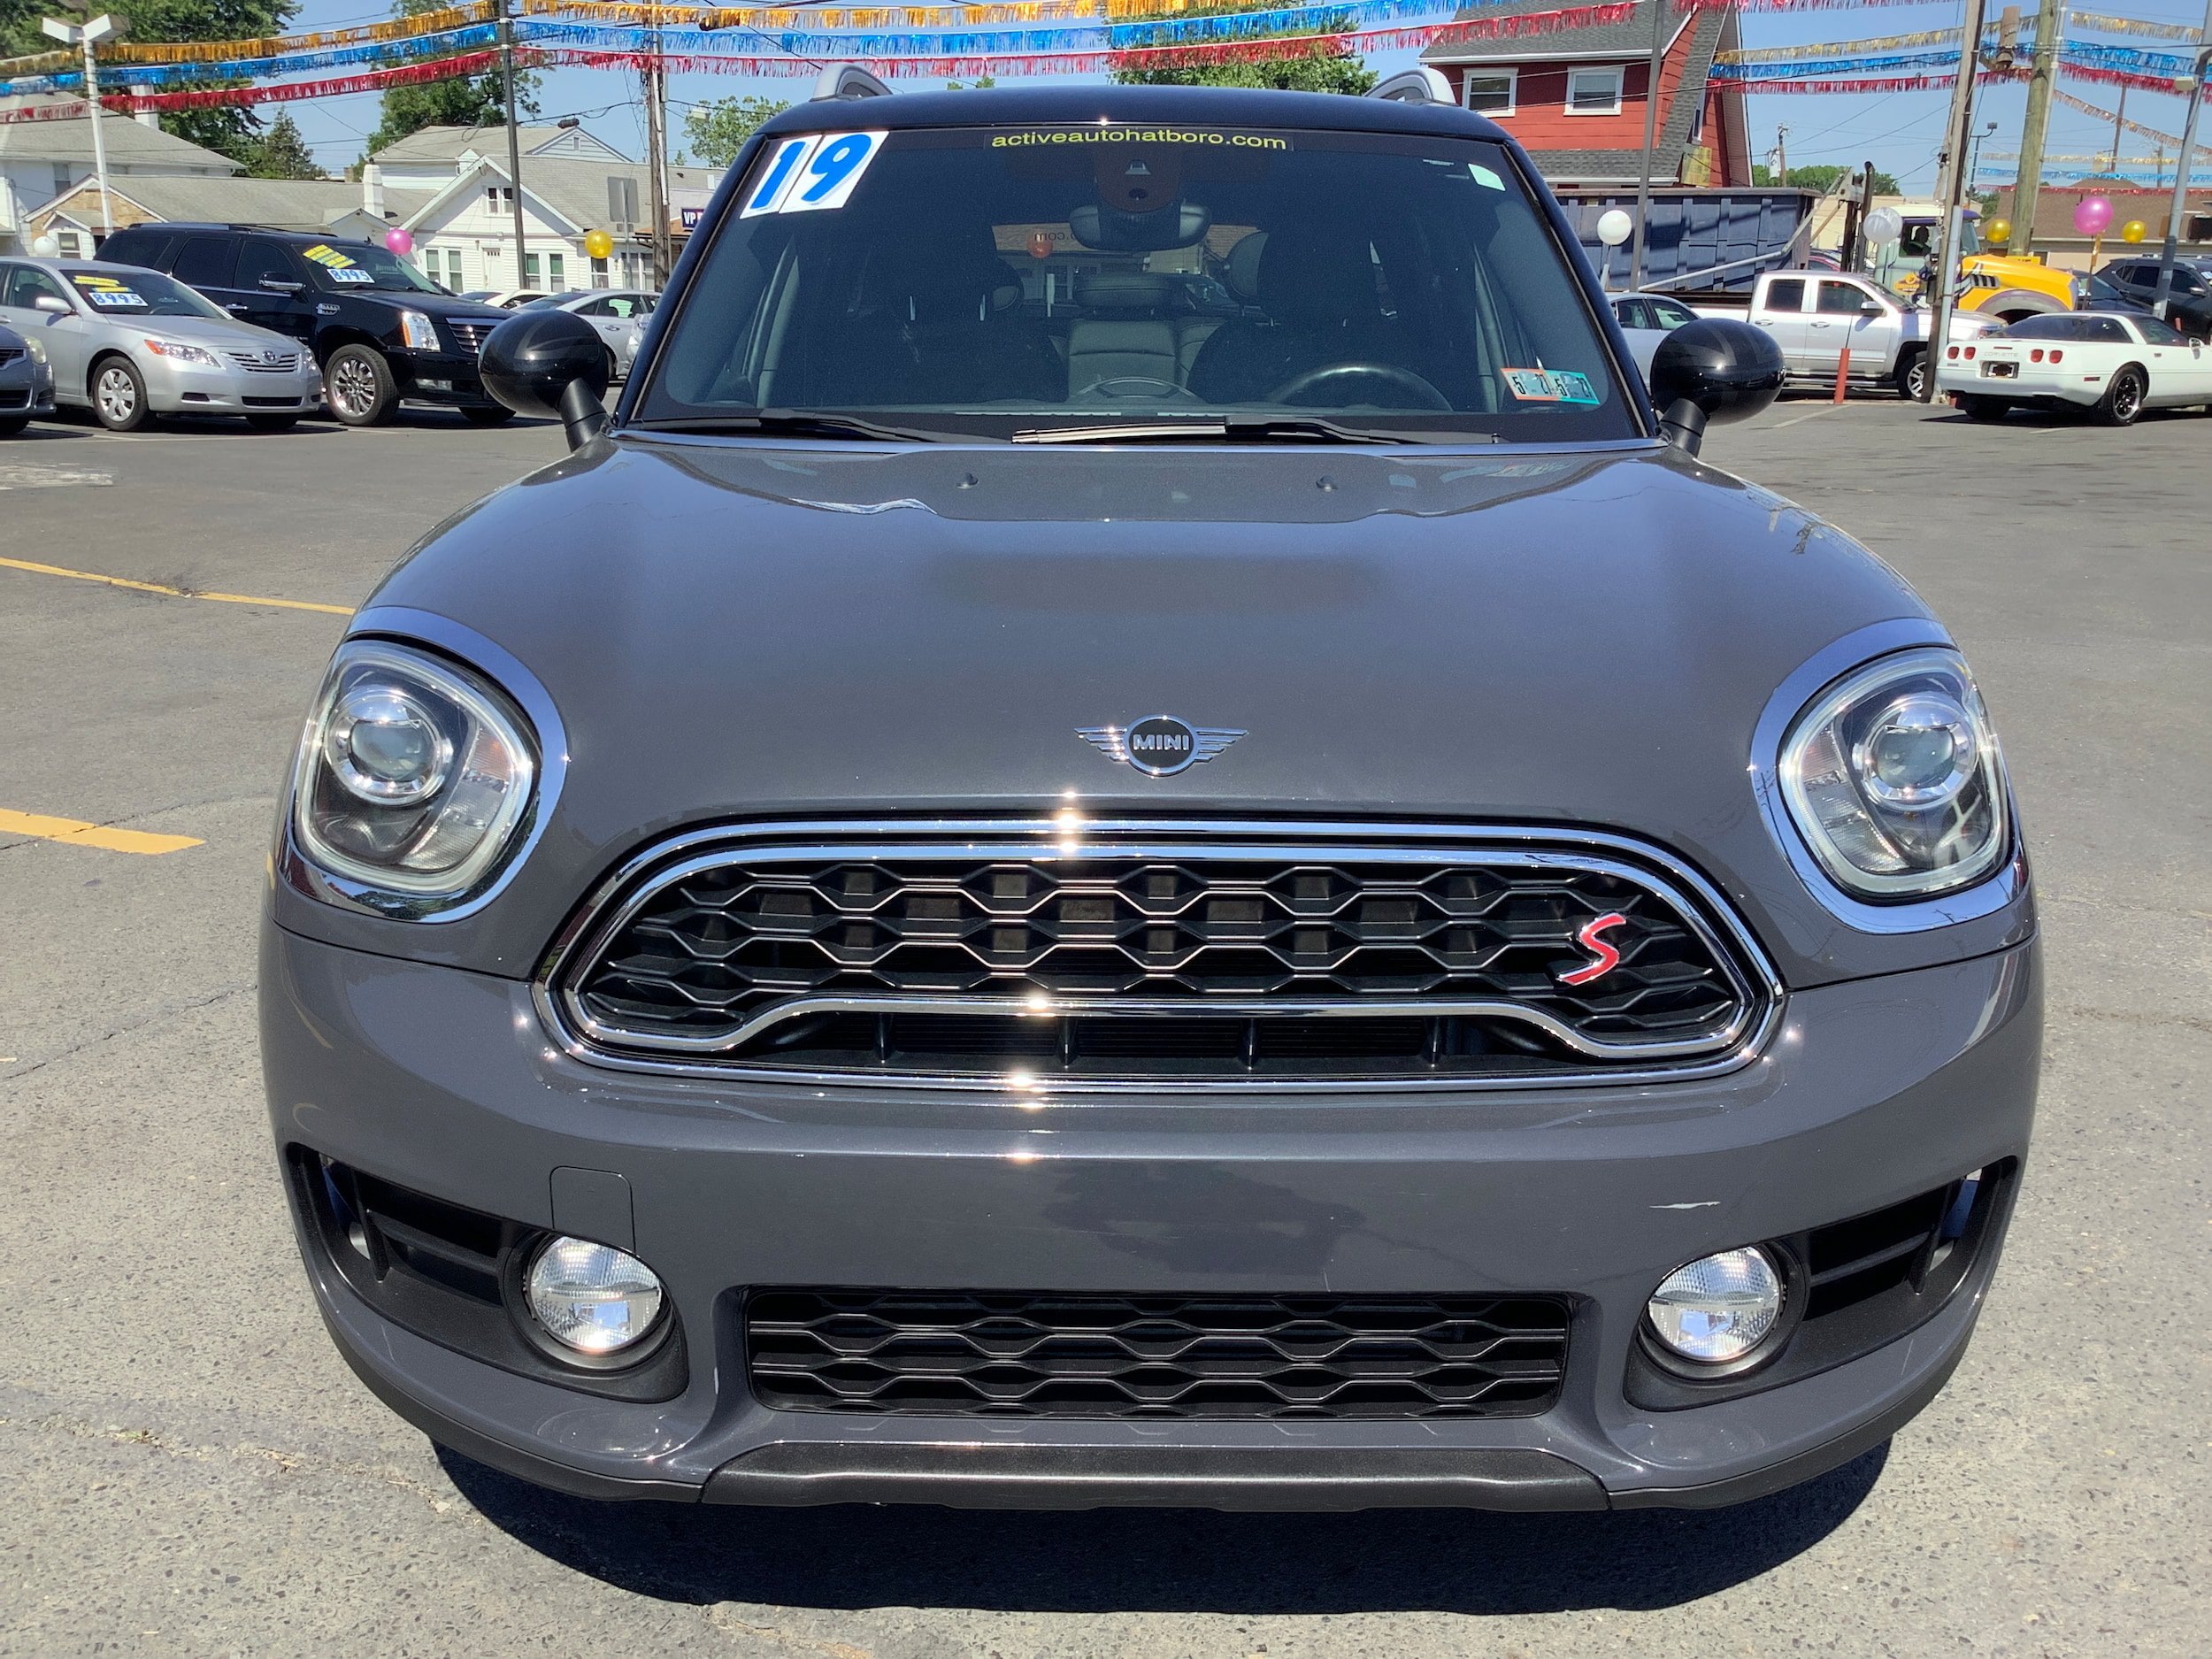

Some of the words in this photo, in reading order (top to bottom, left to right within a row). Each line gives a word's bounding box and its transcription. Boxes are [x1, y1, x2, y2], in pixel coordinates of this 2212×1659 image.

[990, 128, 1287, 150] activeautohatboro.com
[749, 134, 872, 209] 19
[330, 269, 370, 280] 8995
[92, 293, 143, 304] 8995
[1133, 733, 1190, 751] MINI
[1555, 911, 1626, 987] S
